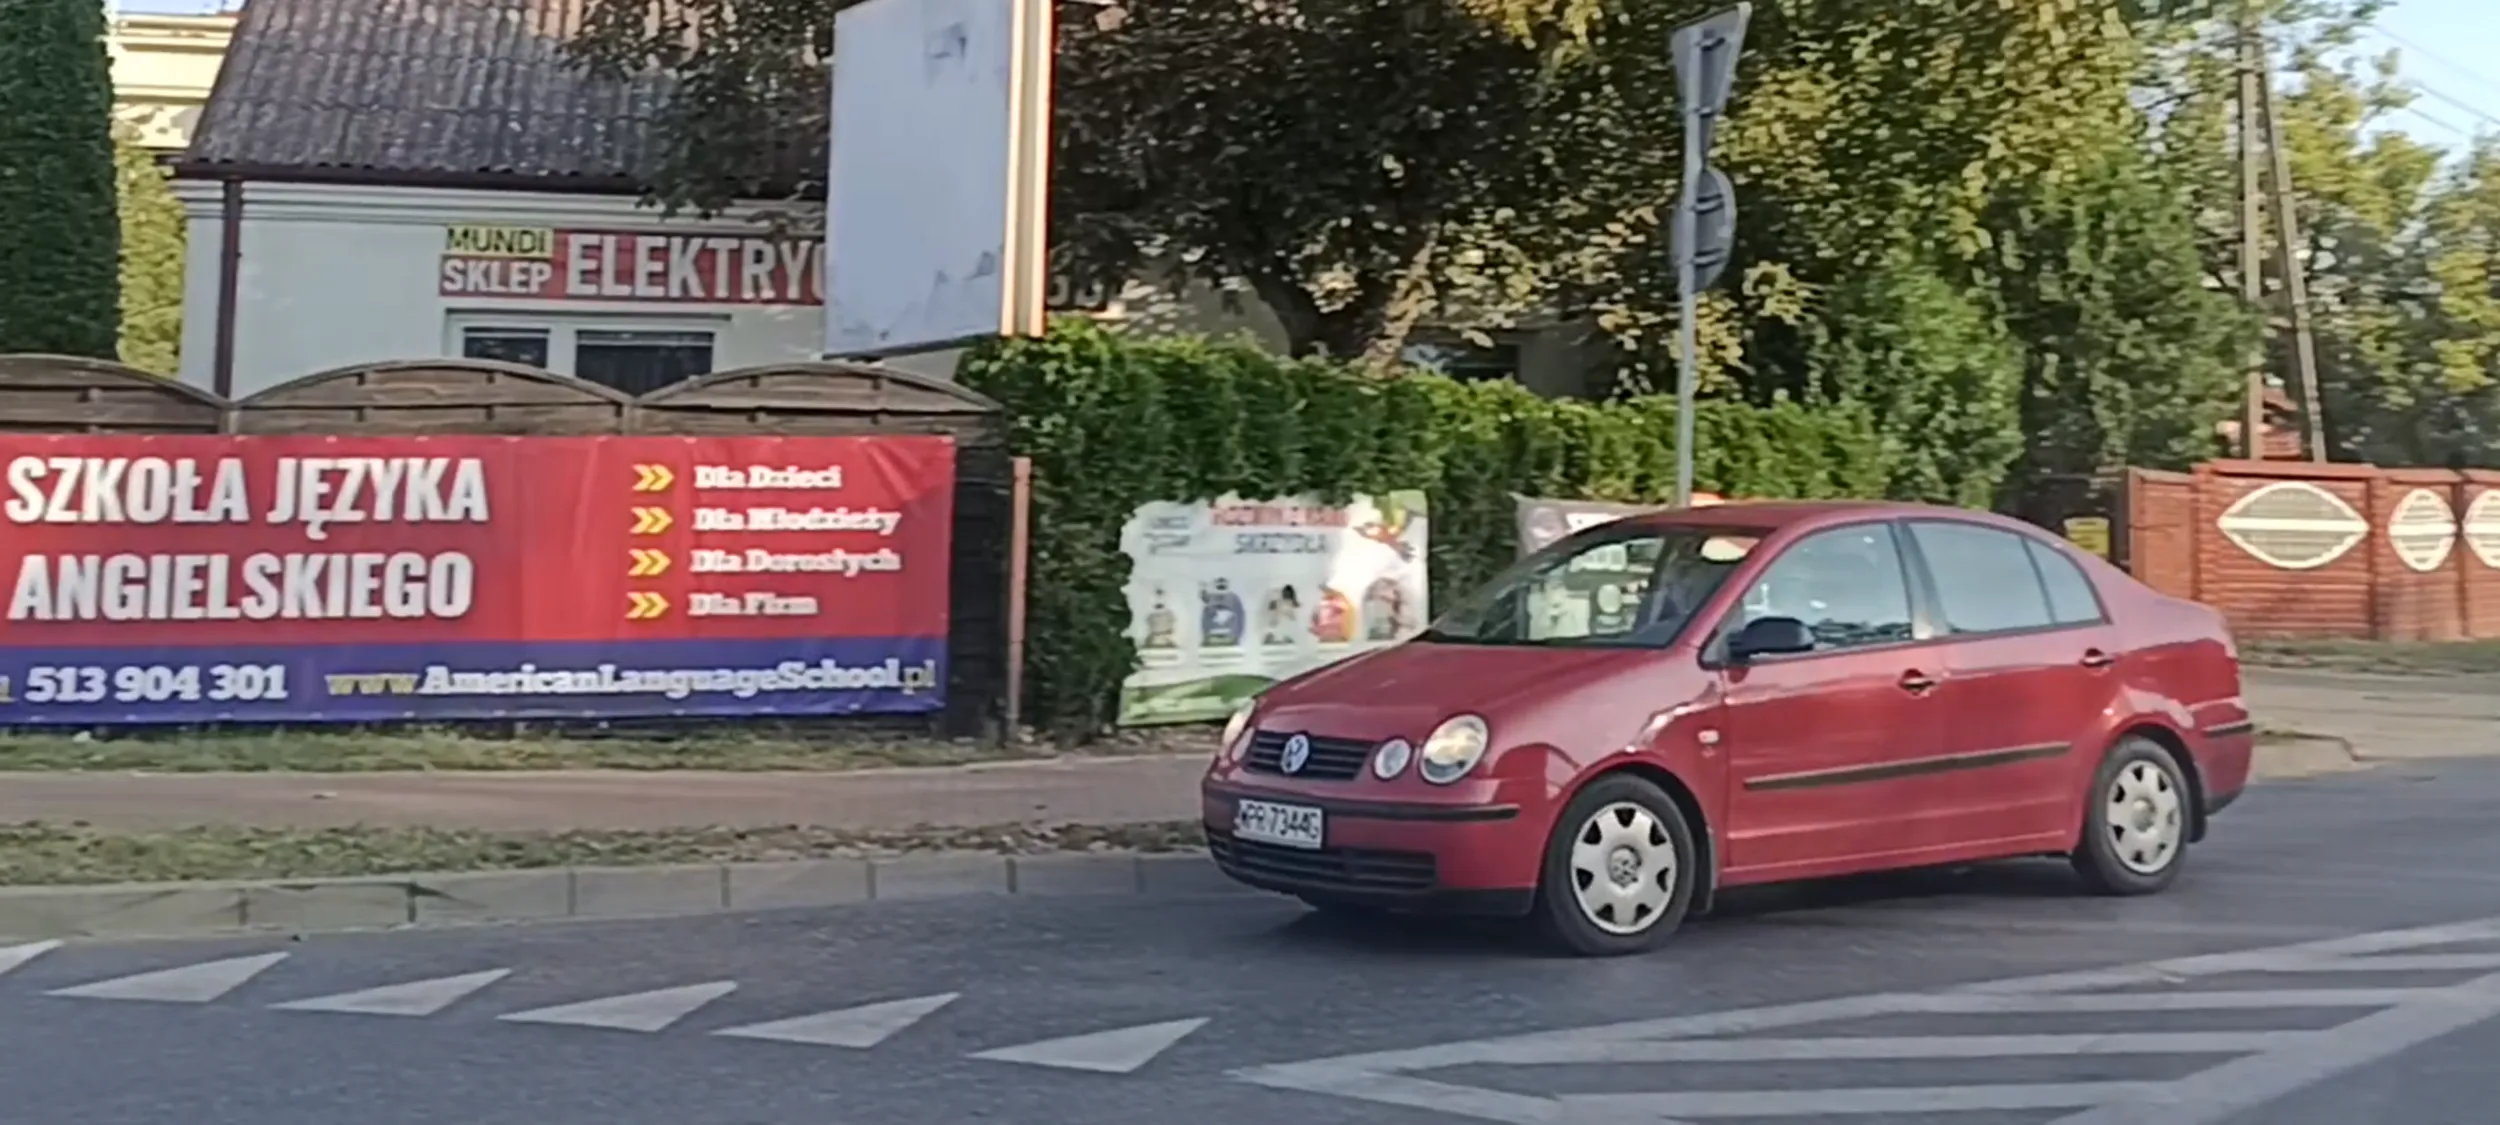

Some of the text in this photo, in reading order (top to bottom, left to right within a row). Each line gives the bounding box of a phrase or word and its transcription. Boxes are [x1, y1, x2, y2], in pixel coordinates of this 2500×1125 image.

[446, 228, 548, 254] MUNDI
[443, 258, 552, 294] SKLEP
[694, 465, 842, 488] Dla Dzieci
[6, 456, 489, 541] SZKOŁA JĘZYKA
[692, 508, 744, 530] Dla
[690, 549, 742, 572] Dla
[7, 553, 474, 620] ANGIELSKIEGO
[687, 592, 818, 615] Dla Firm
[25, 666, 107, 701] 513
[114, 665, 201, 701] 904
[207, 664, 288, 700] 301
